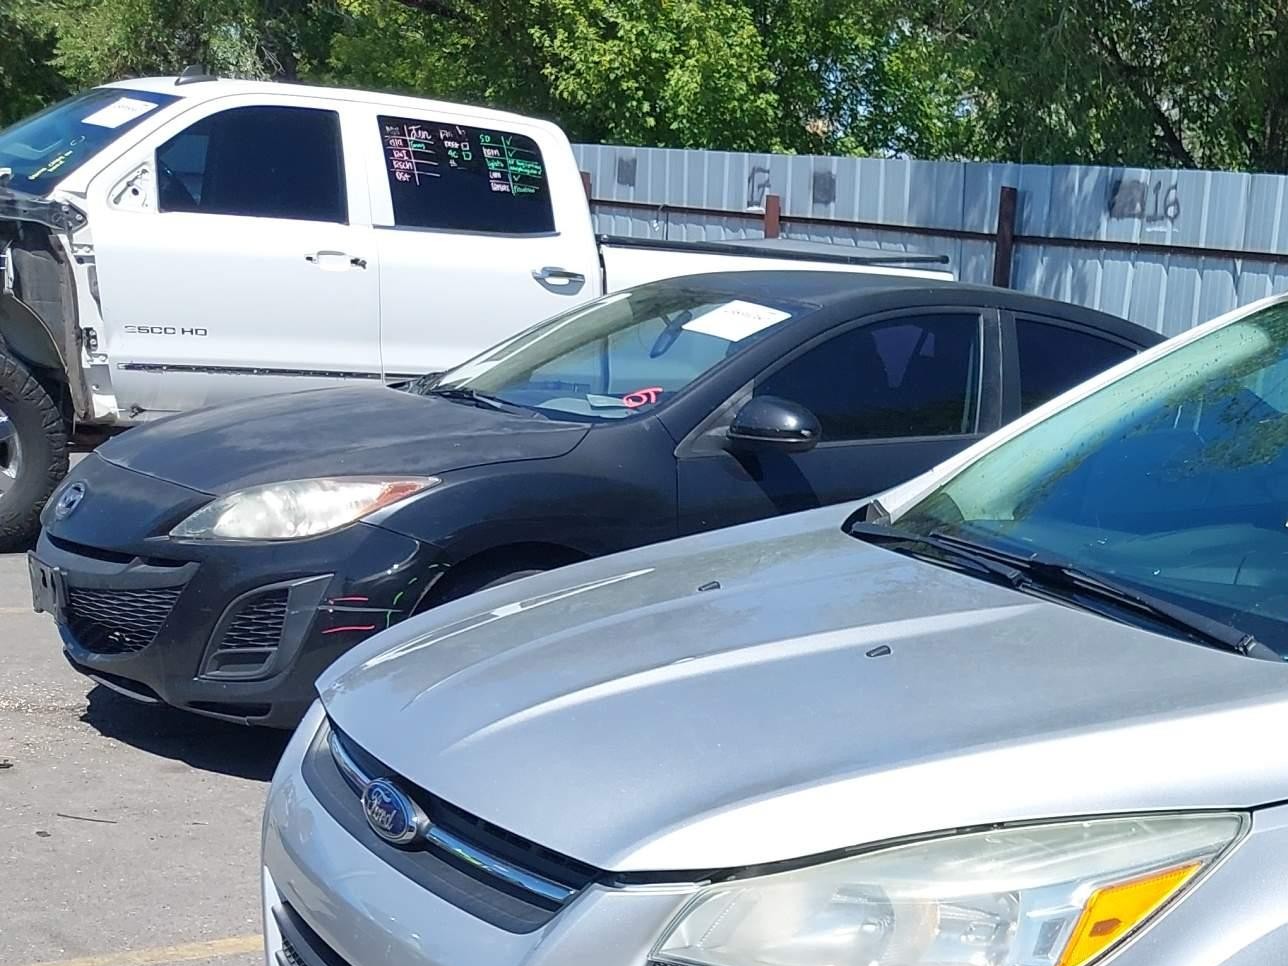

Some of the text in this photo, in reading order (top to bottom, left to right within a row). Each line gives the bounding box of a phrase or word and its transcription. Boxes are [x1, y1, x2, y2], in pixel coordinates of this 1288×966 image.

[1146, 180, 1180, 224] 16
[181, 328, 207, 336] HD
[367, 787, 398, 831] Ford
